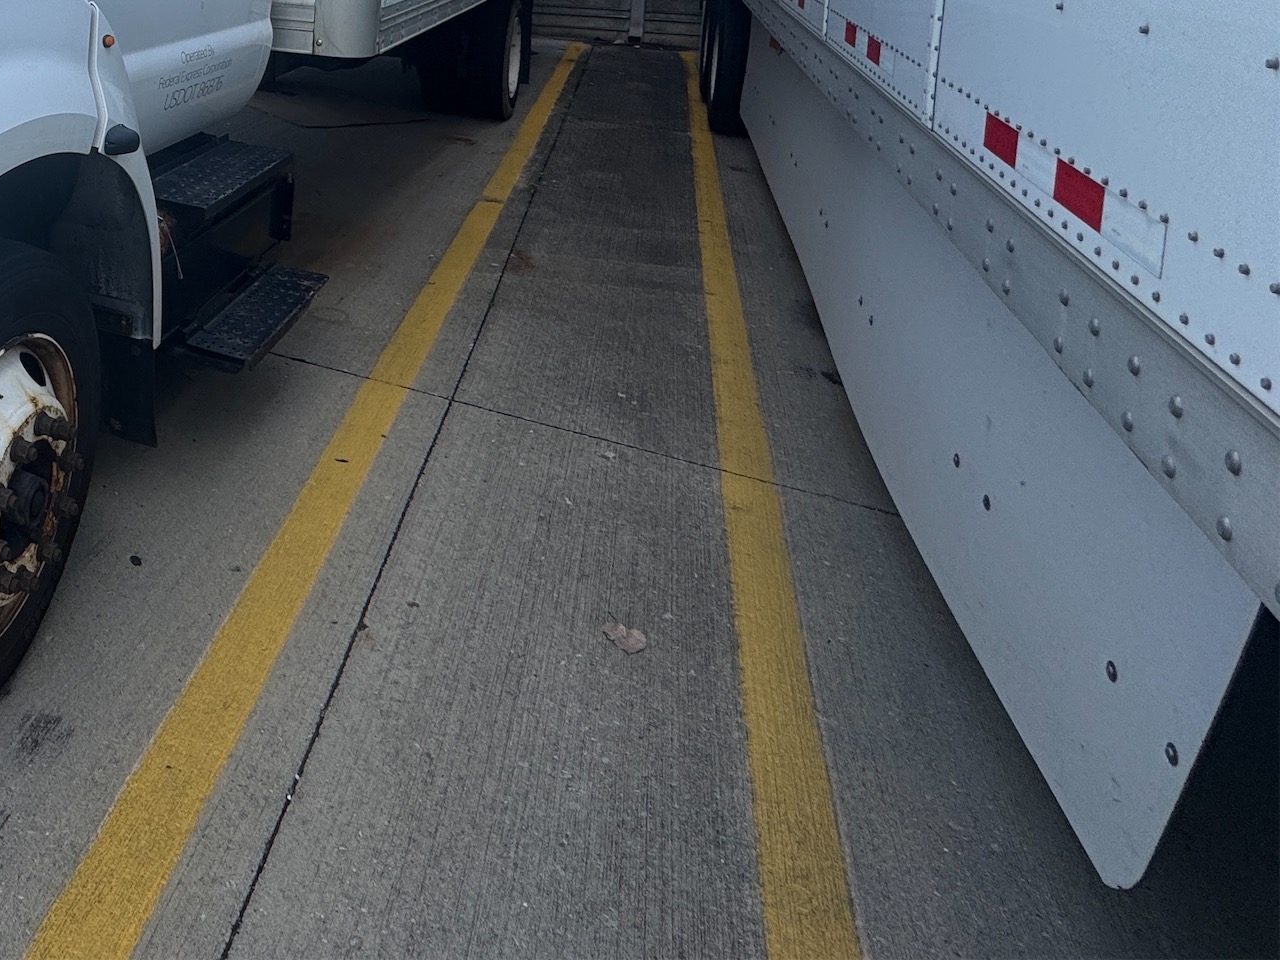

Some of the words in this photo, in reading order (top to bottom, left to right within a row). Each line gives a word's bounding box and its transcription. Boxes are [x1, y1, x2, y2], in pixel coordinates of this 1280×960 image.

[180, 46, 208, 71] Operated
[157, 73, 180, 90] Federal
[180, 67, 203, 83] Express
[163, 83, 200, 111] USDOT
